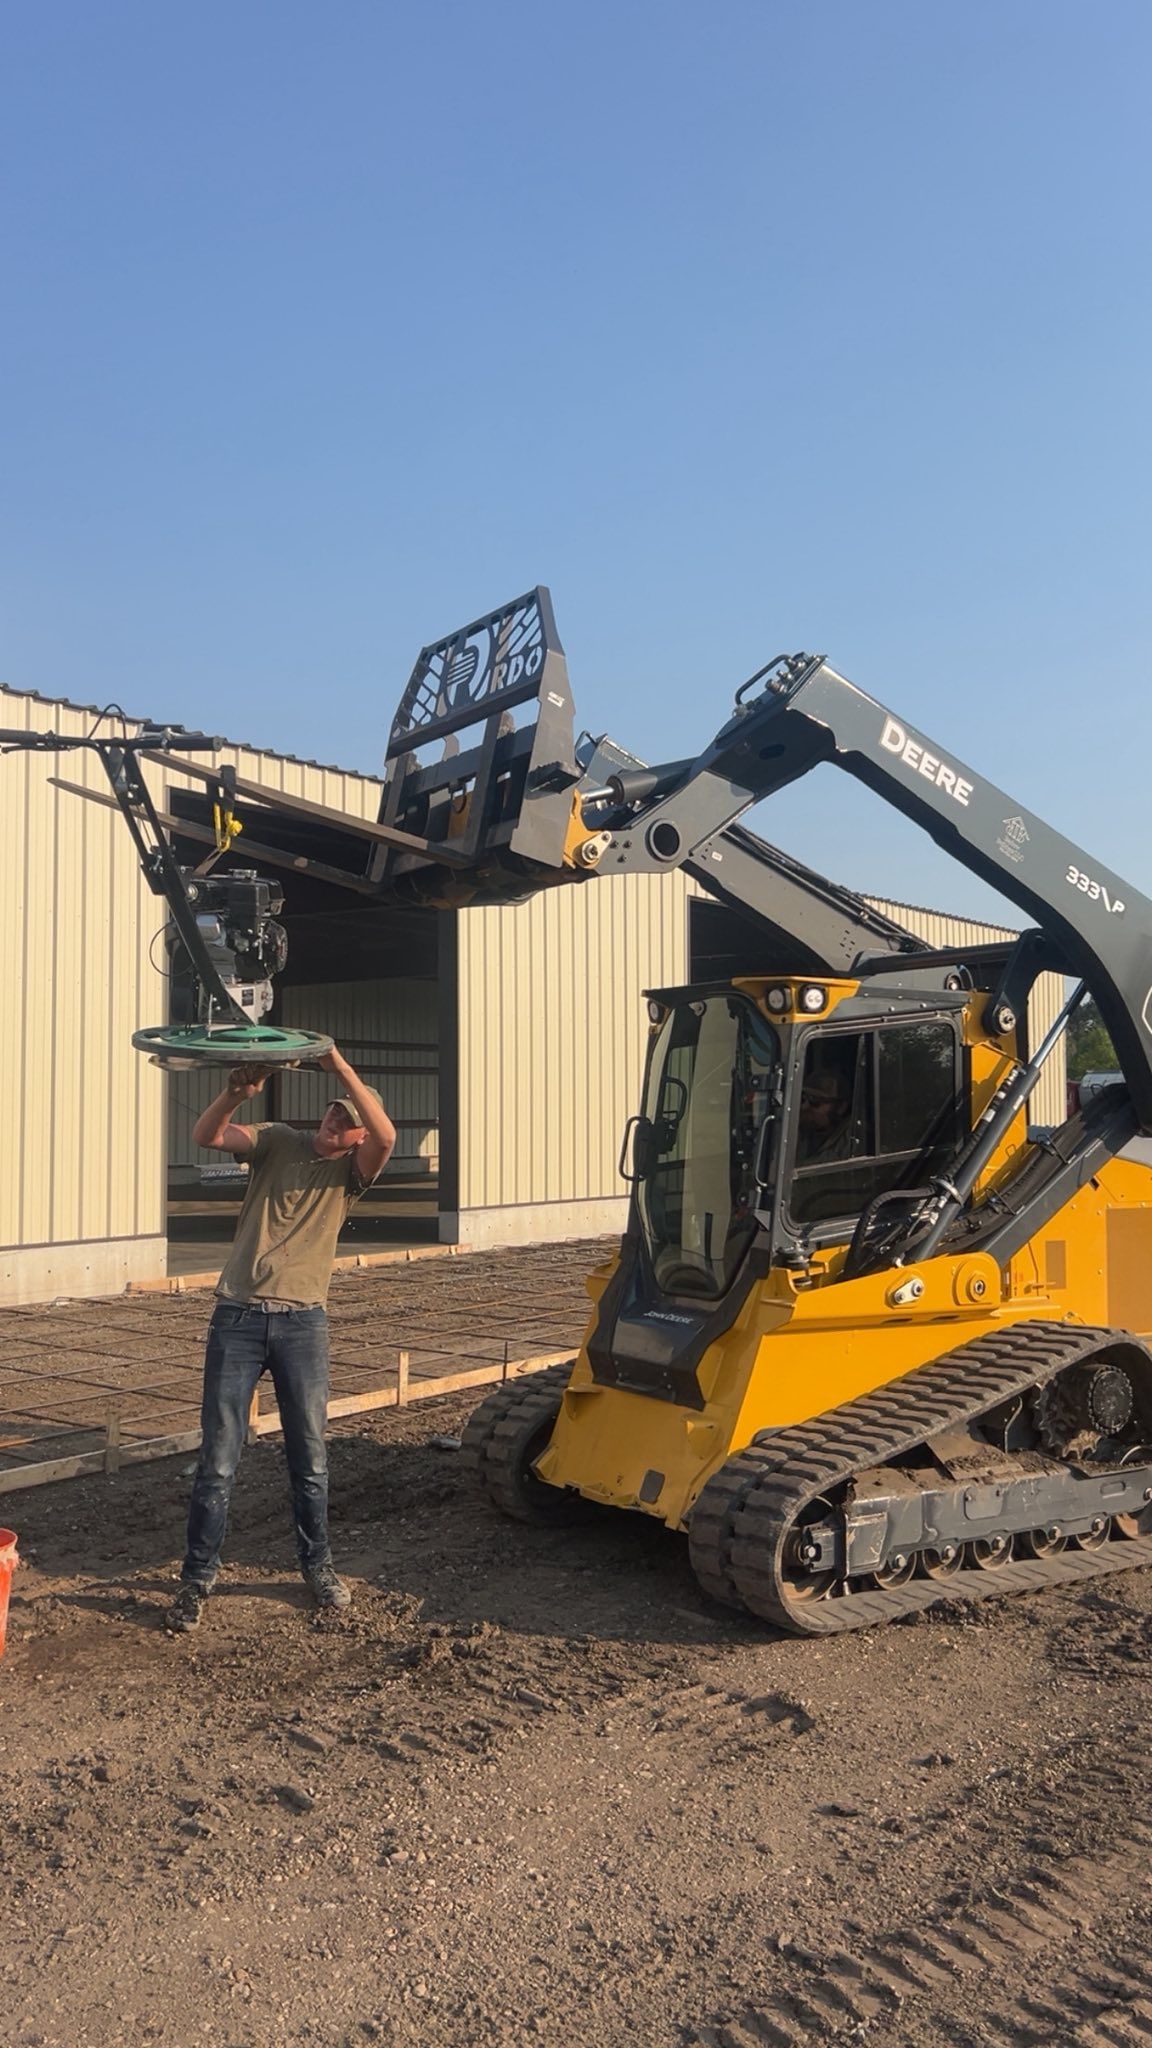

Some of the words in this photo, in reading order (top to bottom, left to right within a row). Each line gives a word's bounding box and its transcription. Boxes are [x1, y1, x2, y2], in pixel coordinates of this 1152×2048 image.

[489, 645, 543, 694] RDO
[880, 719, 974, 807] DEERE
[643, 1310, 667, 1320] JOHN
[664, 1313, 695, 1324] DEERE
